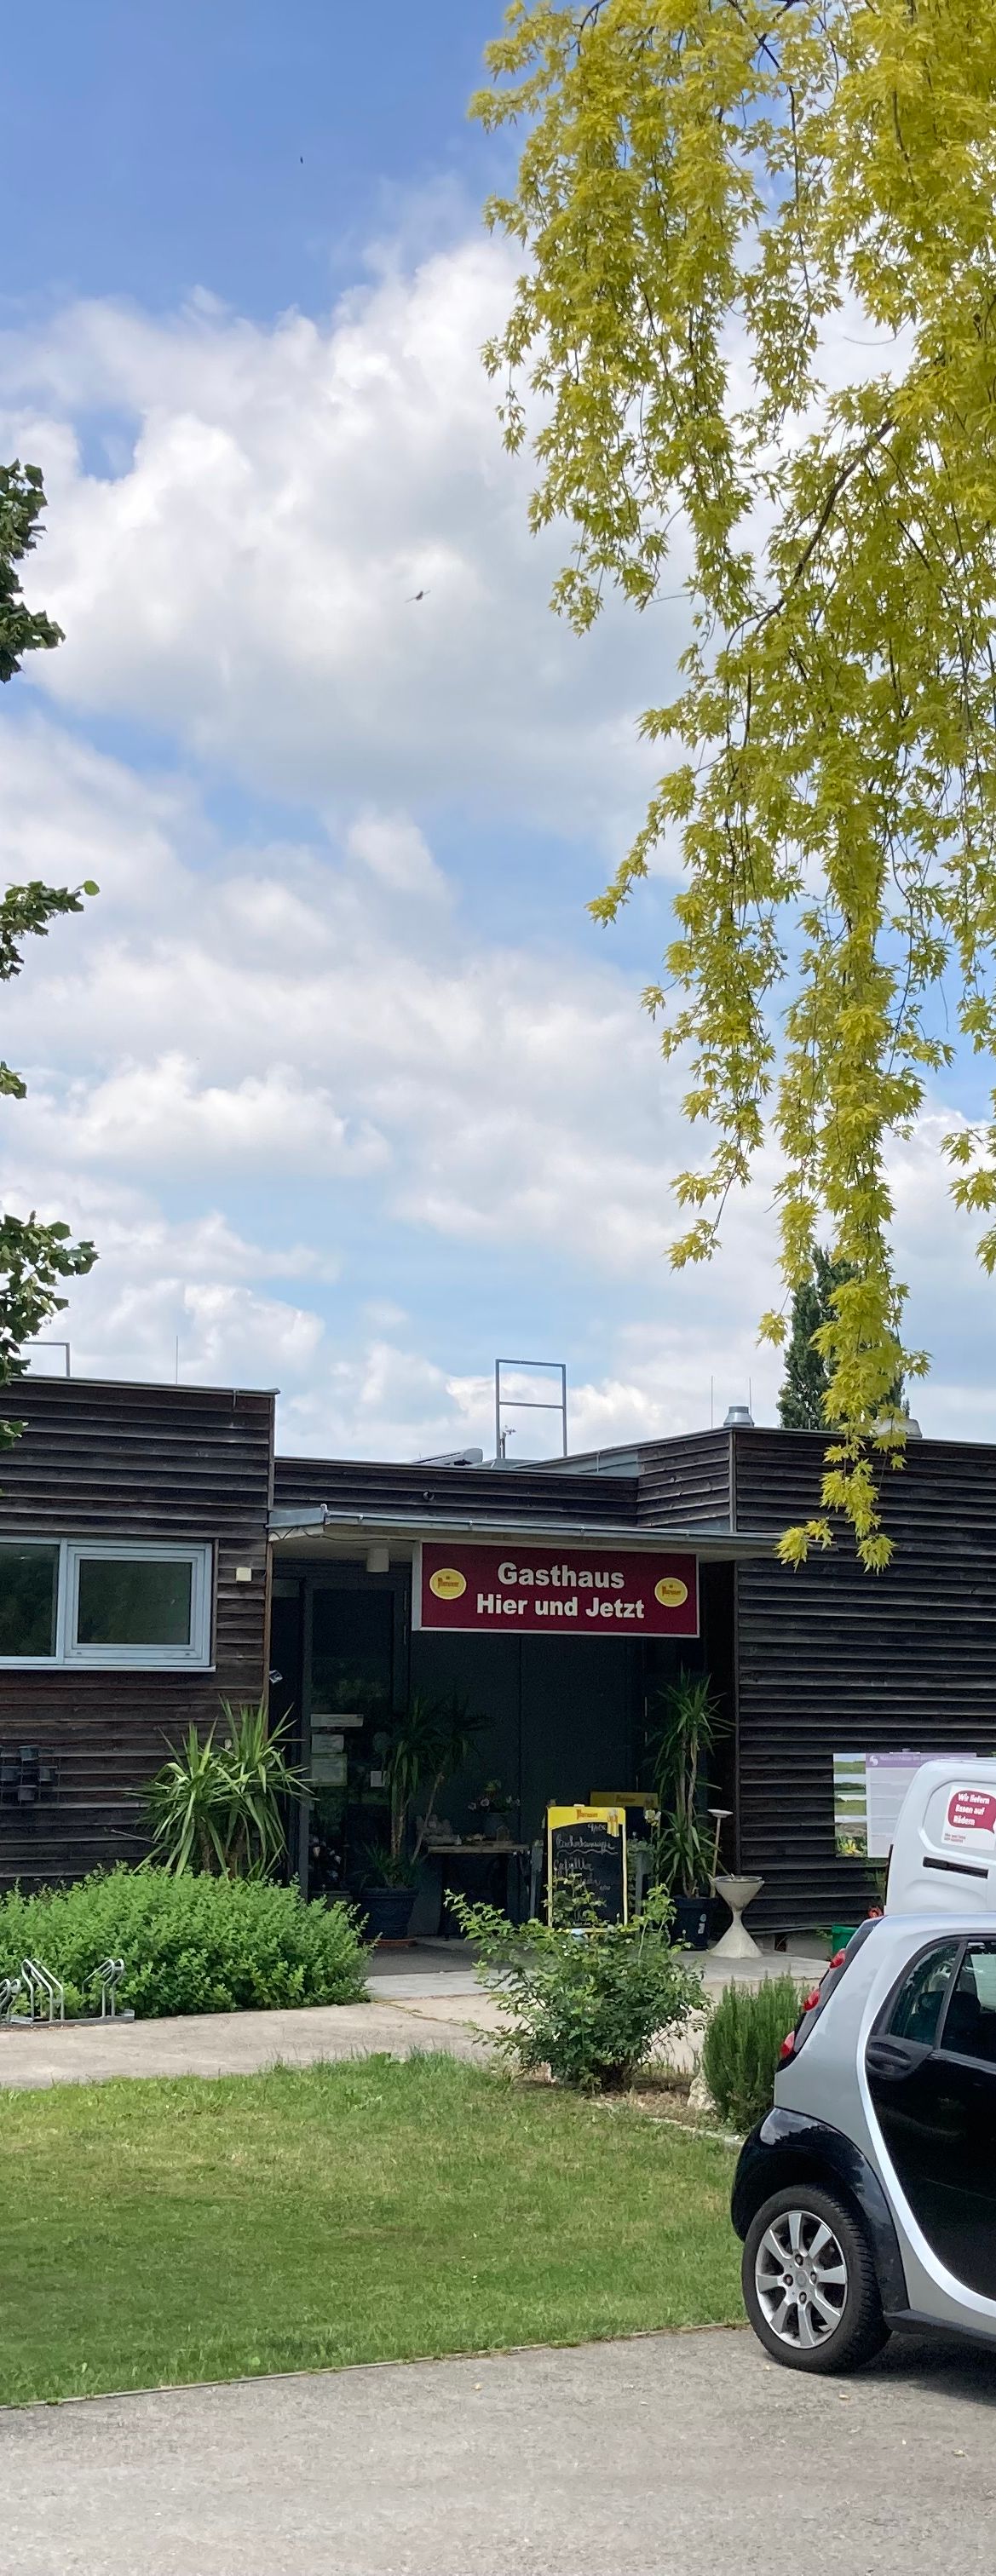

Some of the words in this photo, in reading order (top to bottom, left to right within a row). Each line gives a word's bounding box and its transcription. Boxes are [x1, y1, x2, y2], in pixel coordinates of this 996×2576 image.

[498, 1561, 625, 1589] Gasthaus
[476, 1593, 527, 1615] Hier
[535, 1596, 578, 1617] und
[585, 1597, 644, 1619] Jetzt
[958, 1793, 970, 1802] Wir
[955, 1804, 973, 1814] Essen
[974, 1807, 985, 1815] auf
[953, 1815, 975, 1826] Rädern
